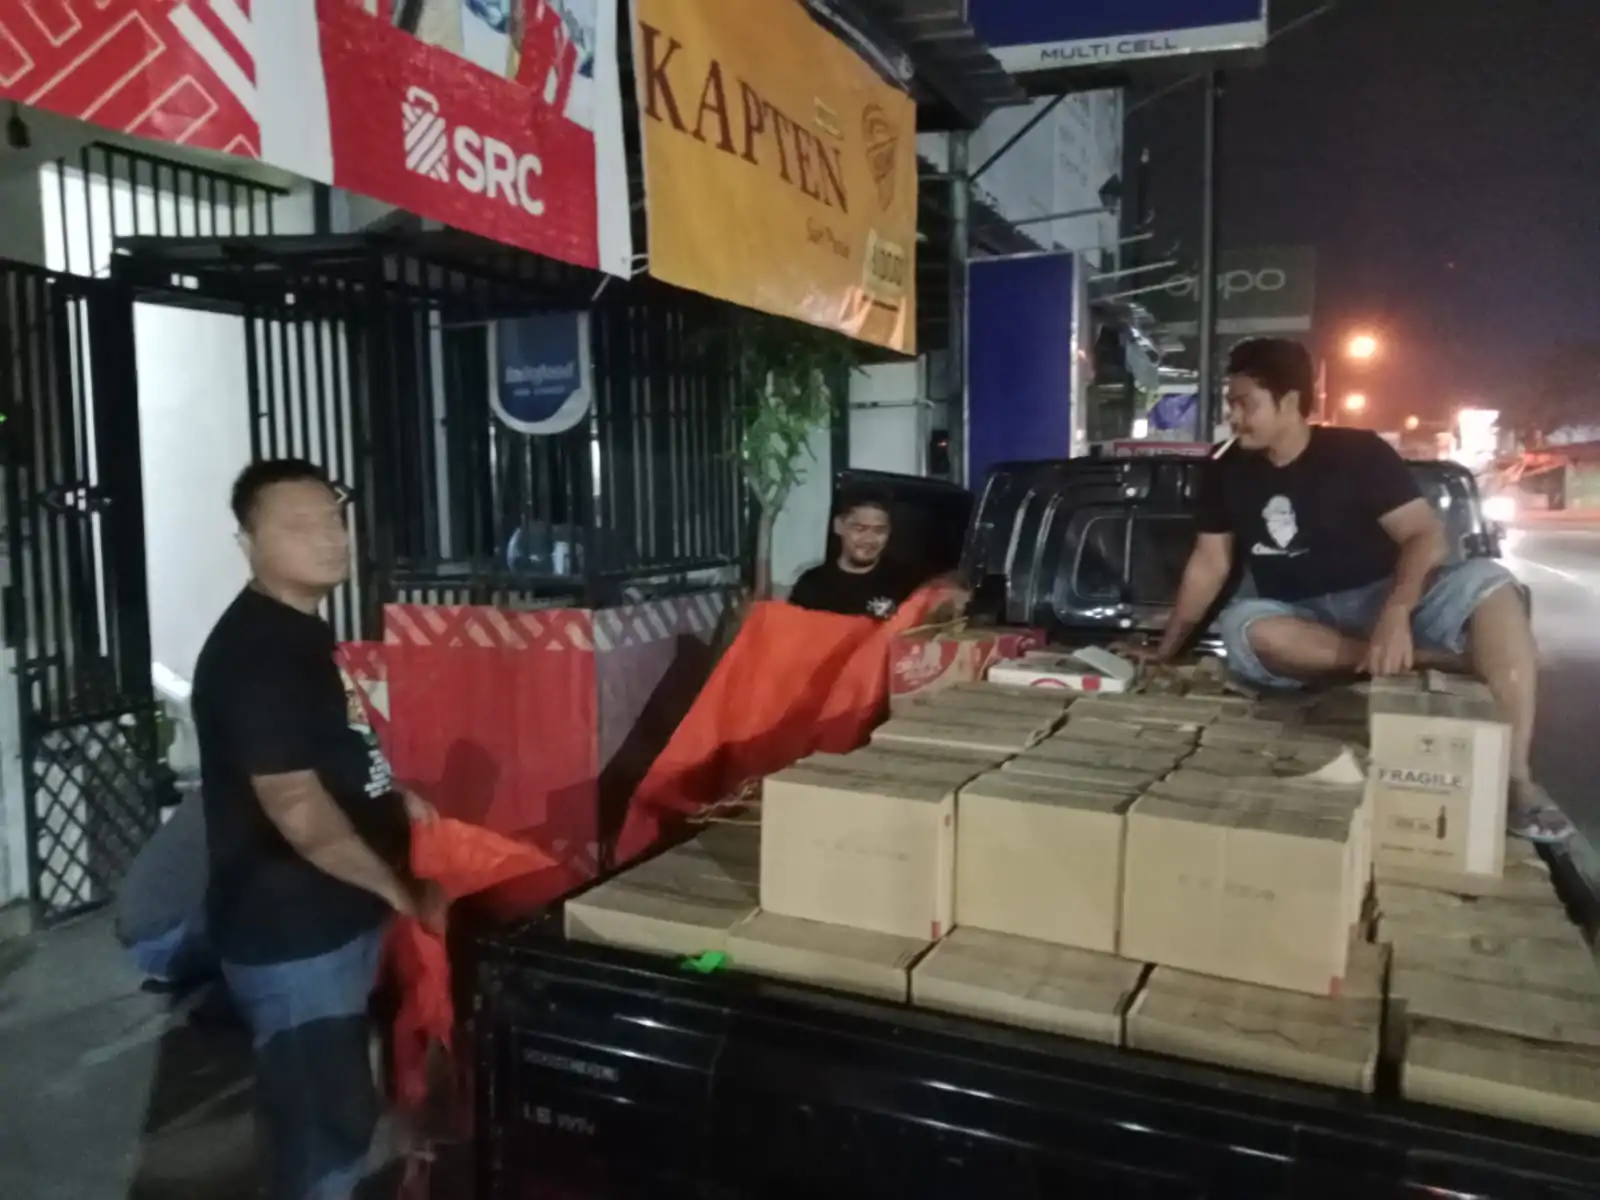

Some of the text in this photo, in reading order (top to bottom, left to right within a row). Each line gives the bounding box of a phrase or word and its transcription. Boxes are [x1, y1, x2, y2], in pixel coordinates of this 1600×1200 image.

[1040, 37, 1177, 61] MULTI CELL
[638, 20, 848, 214] KAPTEN
[453, 125, 545, 217] SRC
[1379, 767, 1463, 788] FRAGILE
